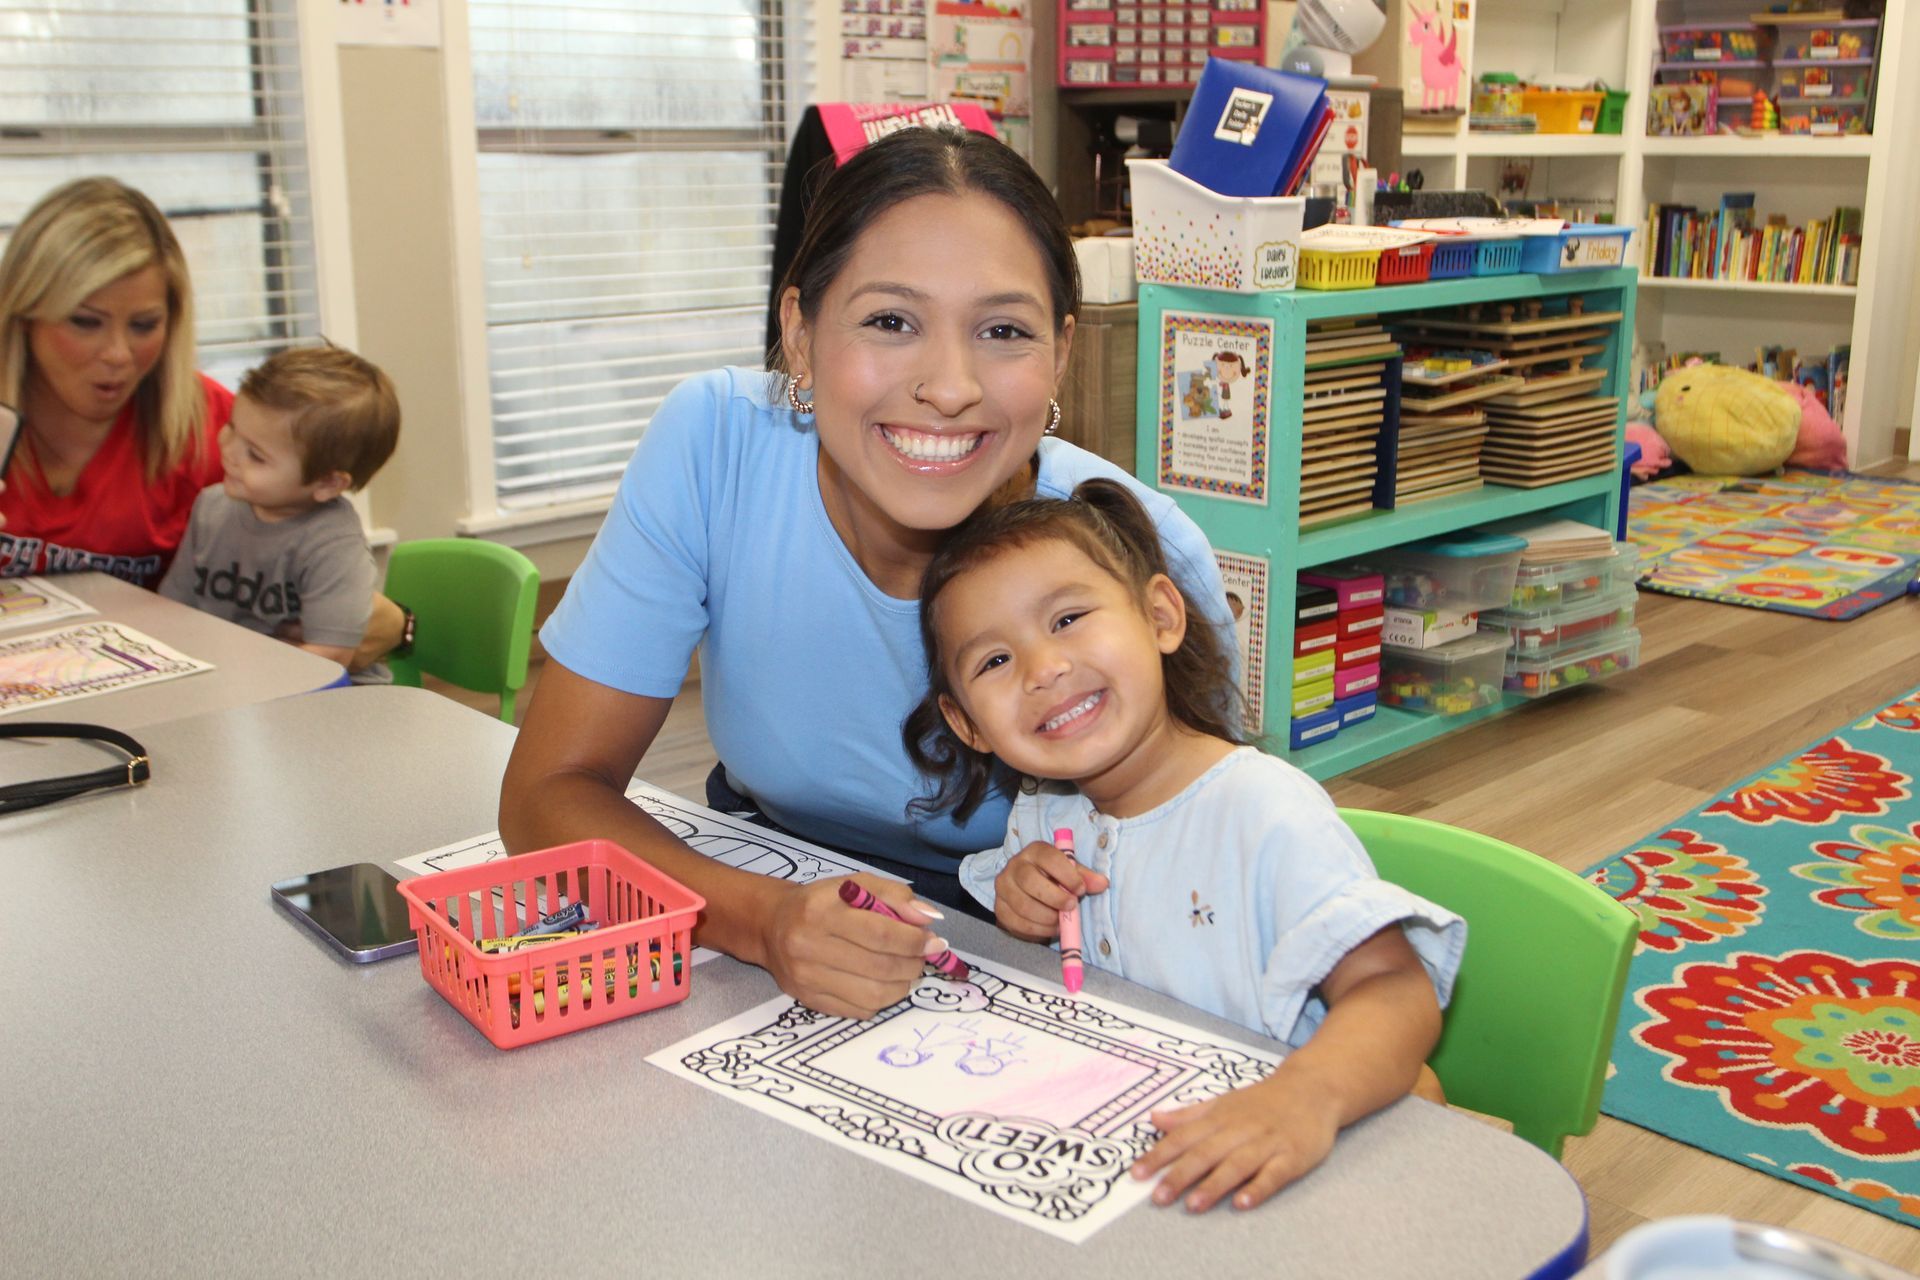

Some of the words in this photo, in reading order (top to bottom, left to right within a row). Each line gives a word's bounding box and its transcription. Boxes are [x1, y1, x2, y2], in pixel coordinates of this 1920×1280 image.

[1586, 239, 1618, 265] Friday
[1182, 333, 1213, 347] Puzzle
[1217, 337, 1250, 351] Center
[193, 560, 303, 616] addas
[1222, 573, 1251, 588] Center
[955, 1117, 1115, 1167] SWEET!
[993, 1151, 1057, 1178] SO
